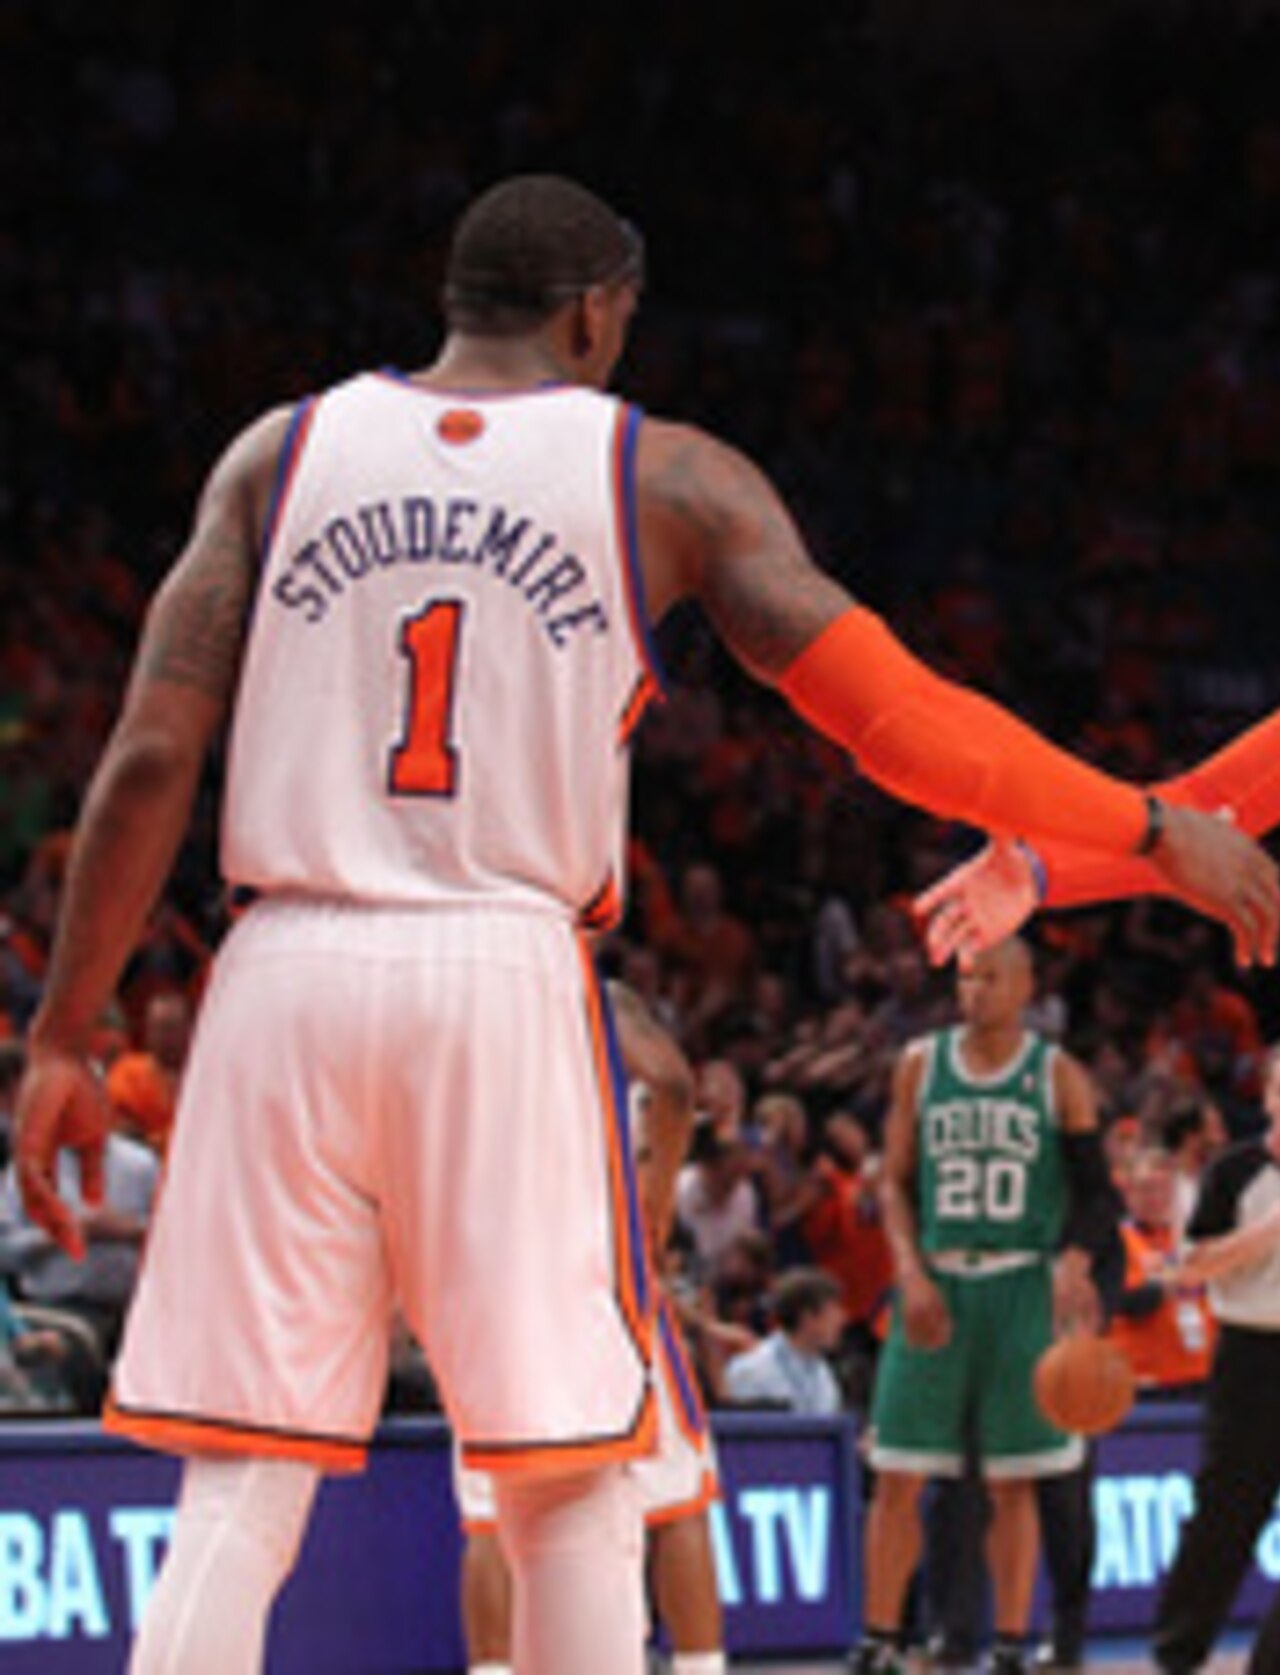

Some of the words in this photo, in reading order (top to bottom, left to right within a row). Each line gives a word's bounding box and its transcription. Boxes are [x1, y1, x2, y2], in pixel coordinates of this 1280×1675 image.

[272, 496, 608, 649] STOUDEMIRE
[388, 597, 464, 798] 1
[935, 1157, 1027, 1221] 20
[109, 1506, 178, 1630] T
[737, 1485, 830, 1603] TV
